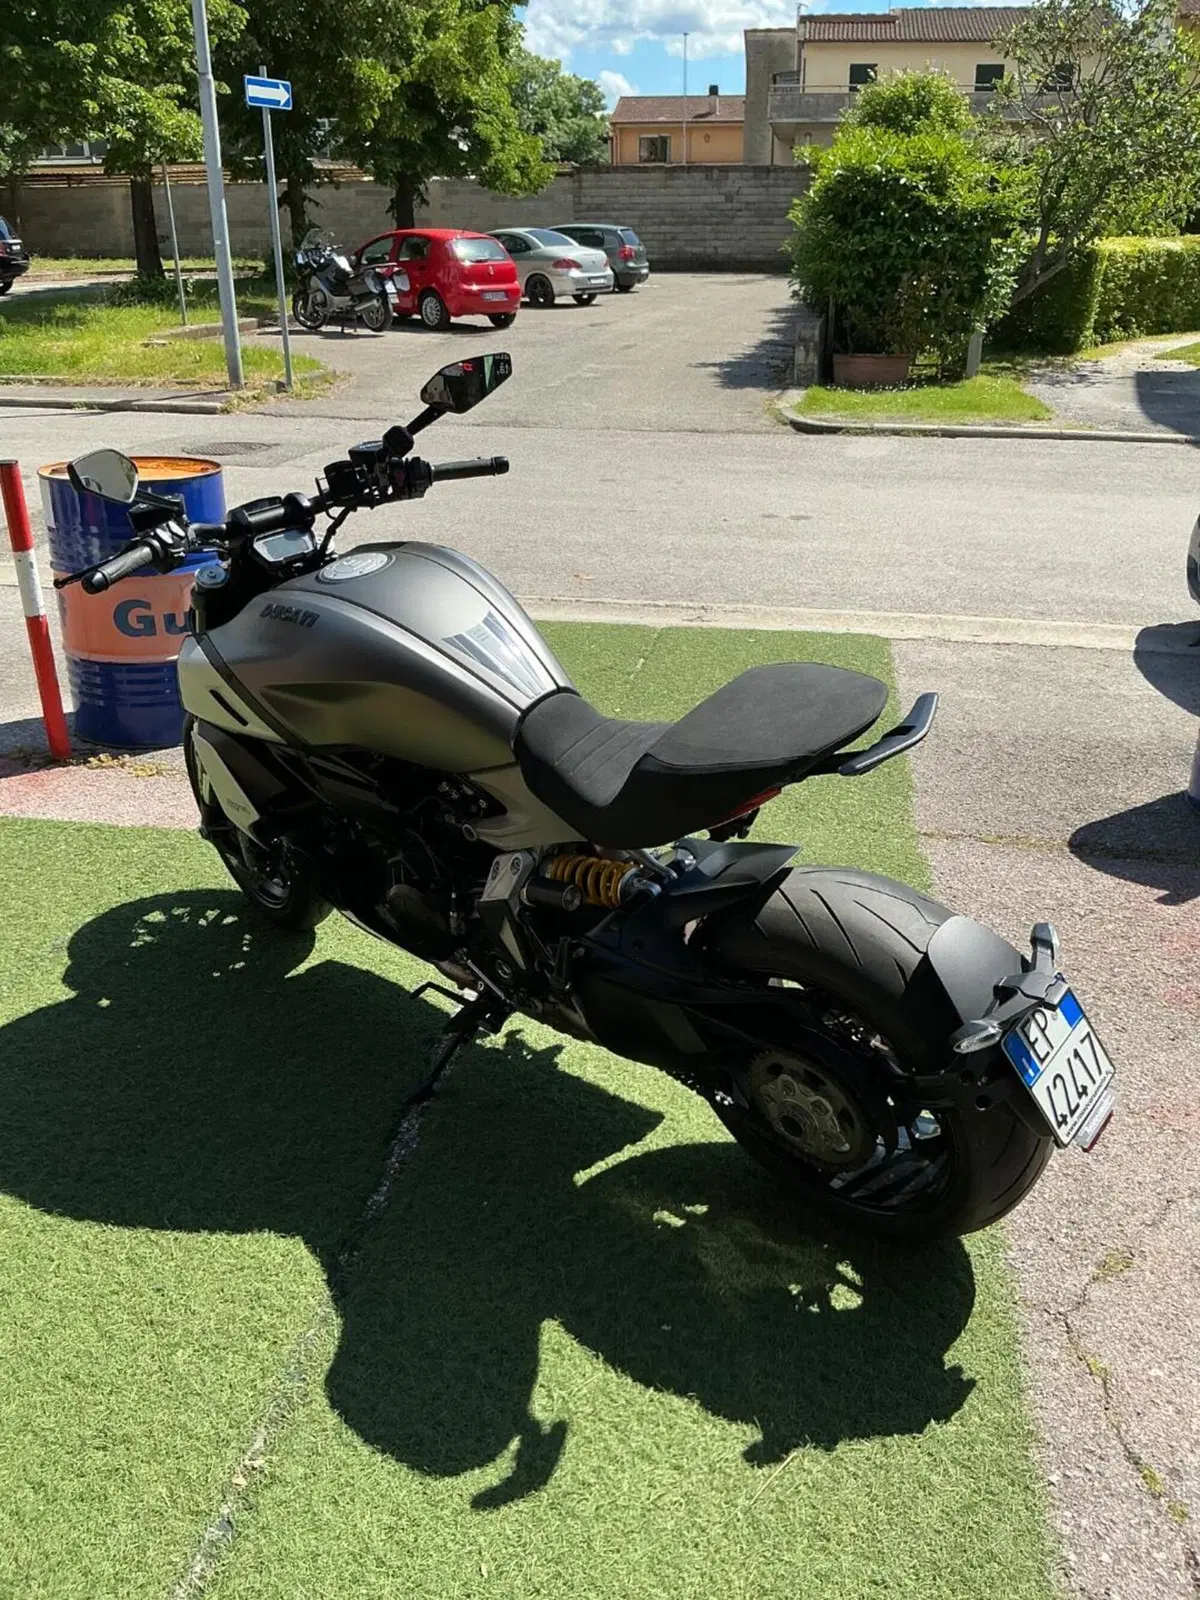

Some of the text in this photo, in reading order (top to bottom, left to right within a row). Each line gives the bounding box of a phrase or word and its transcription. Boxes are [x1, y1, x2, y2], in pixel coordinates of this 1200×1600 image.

[259, 602, 321, 629] DUCATI
[1019, 1008, 1054, 1065] EP
[1046, 1031, 1103, 1130] 42417
